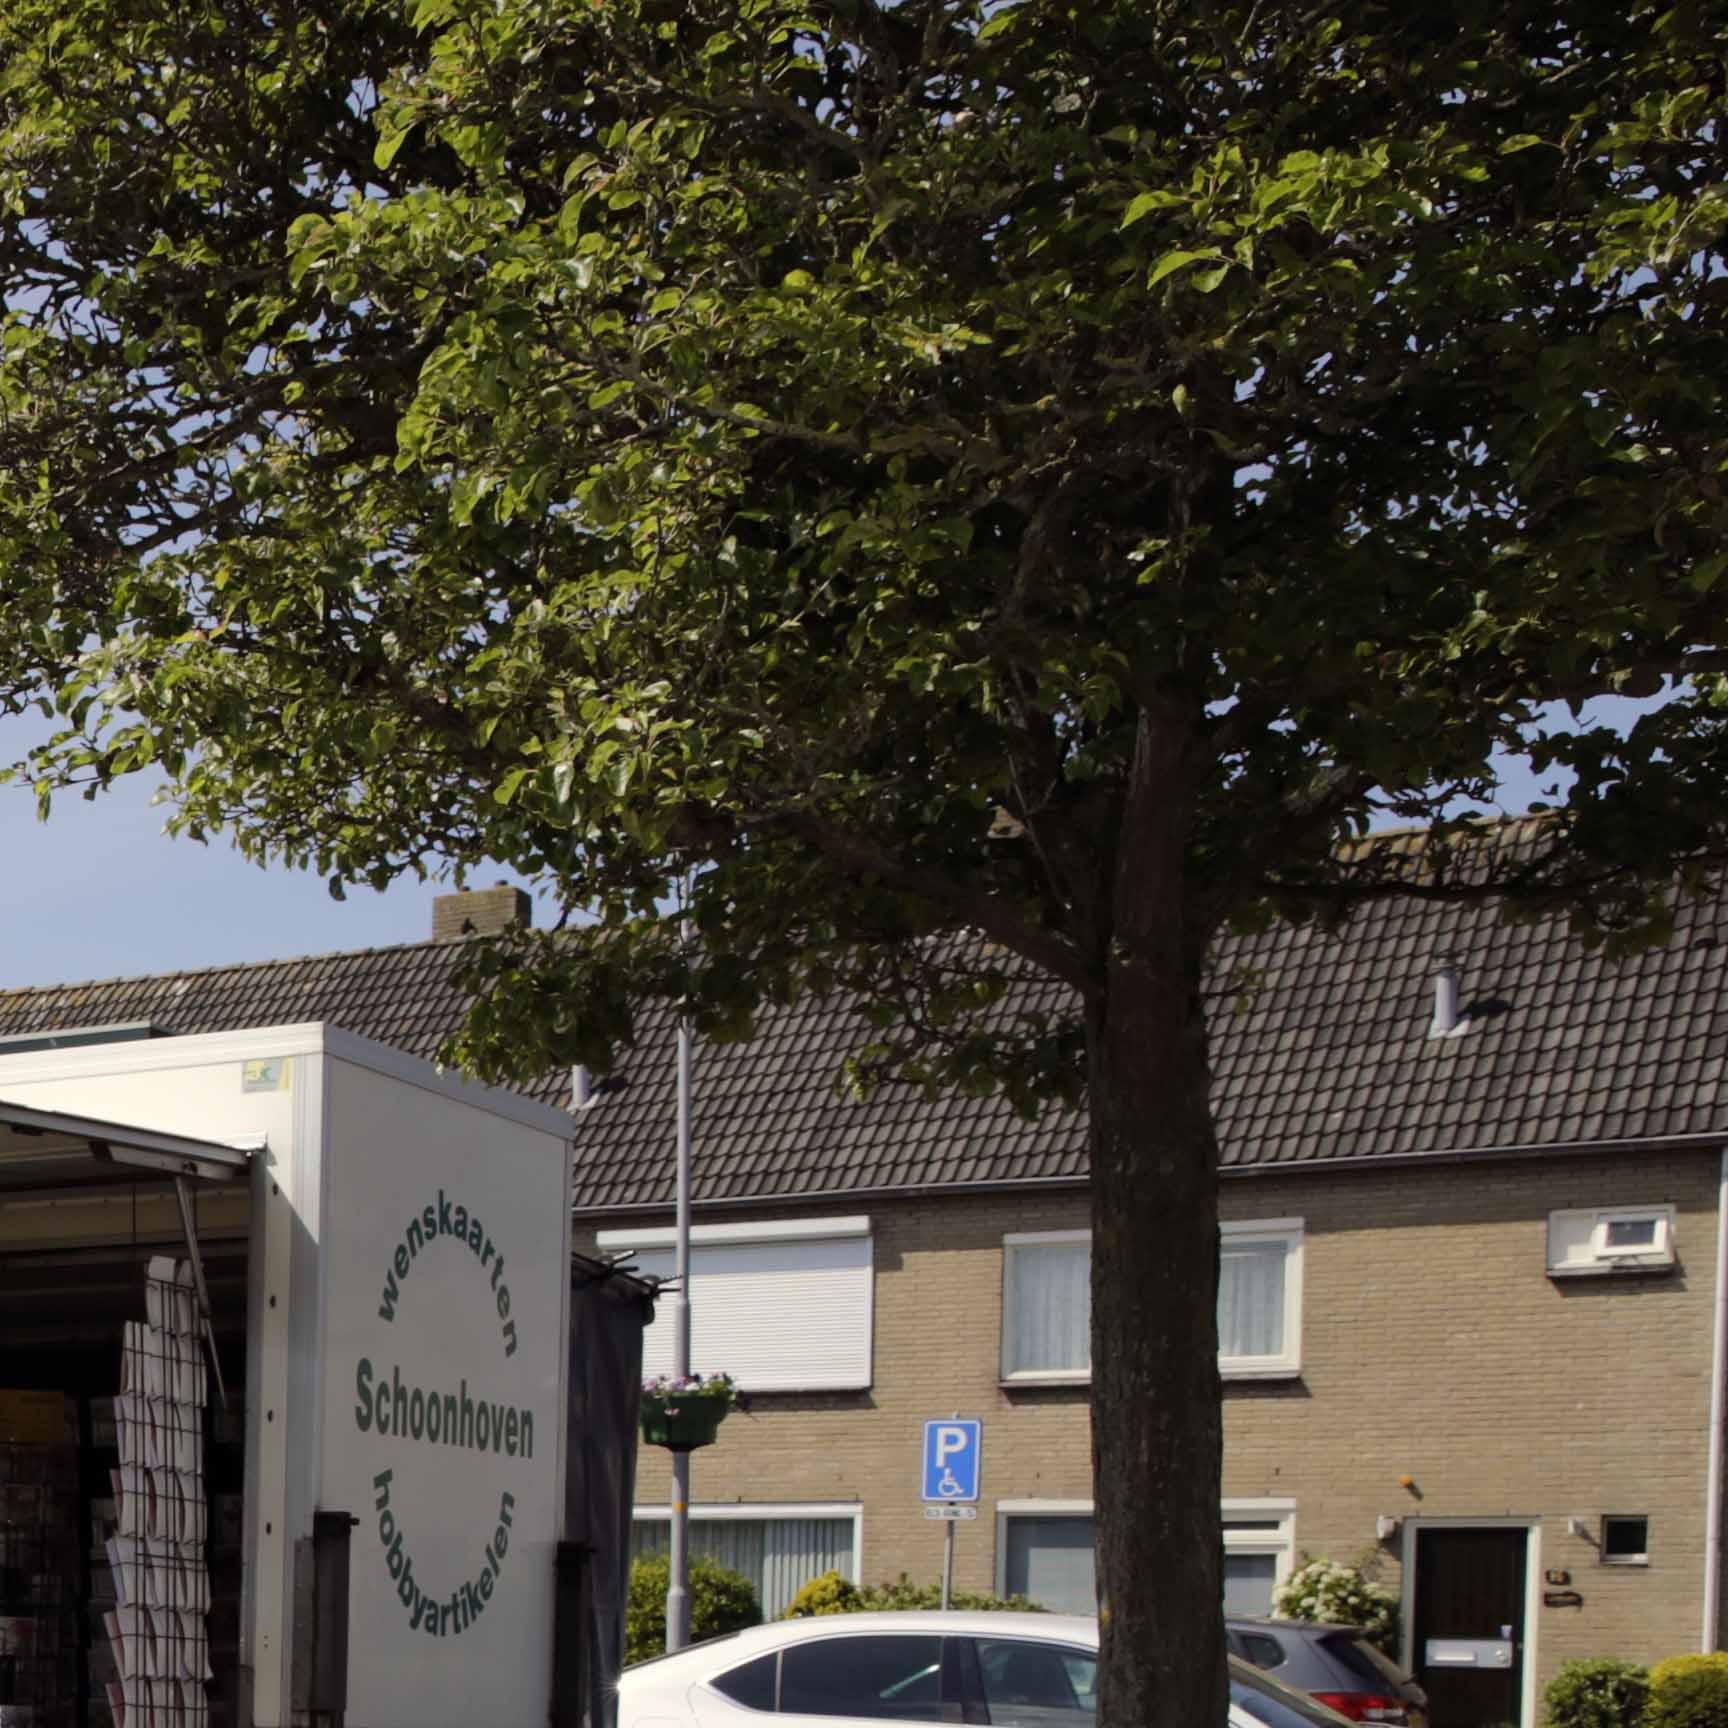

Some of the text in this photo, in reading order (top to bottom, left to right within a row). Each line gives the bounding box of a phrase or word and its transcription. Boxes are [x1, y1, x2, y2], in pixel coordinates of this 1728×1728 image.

[379, 1189, 517, 1357] wenskaarten
[355, 1357, 534, 1460] Schoonhoven
[935, 1426, 968, 1468] P
[373, 1468, 515, 1637] hobbyartikelen
